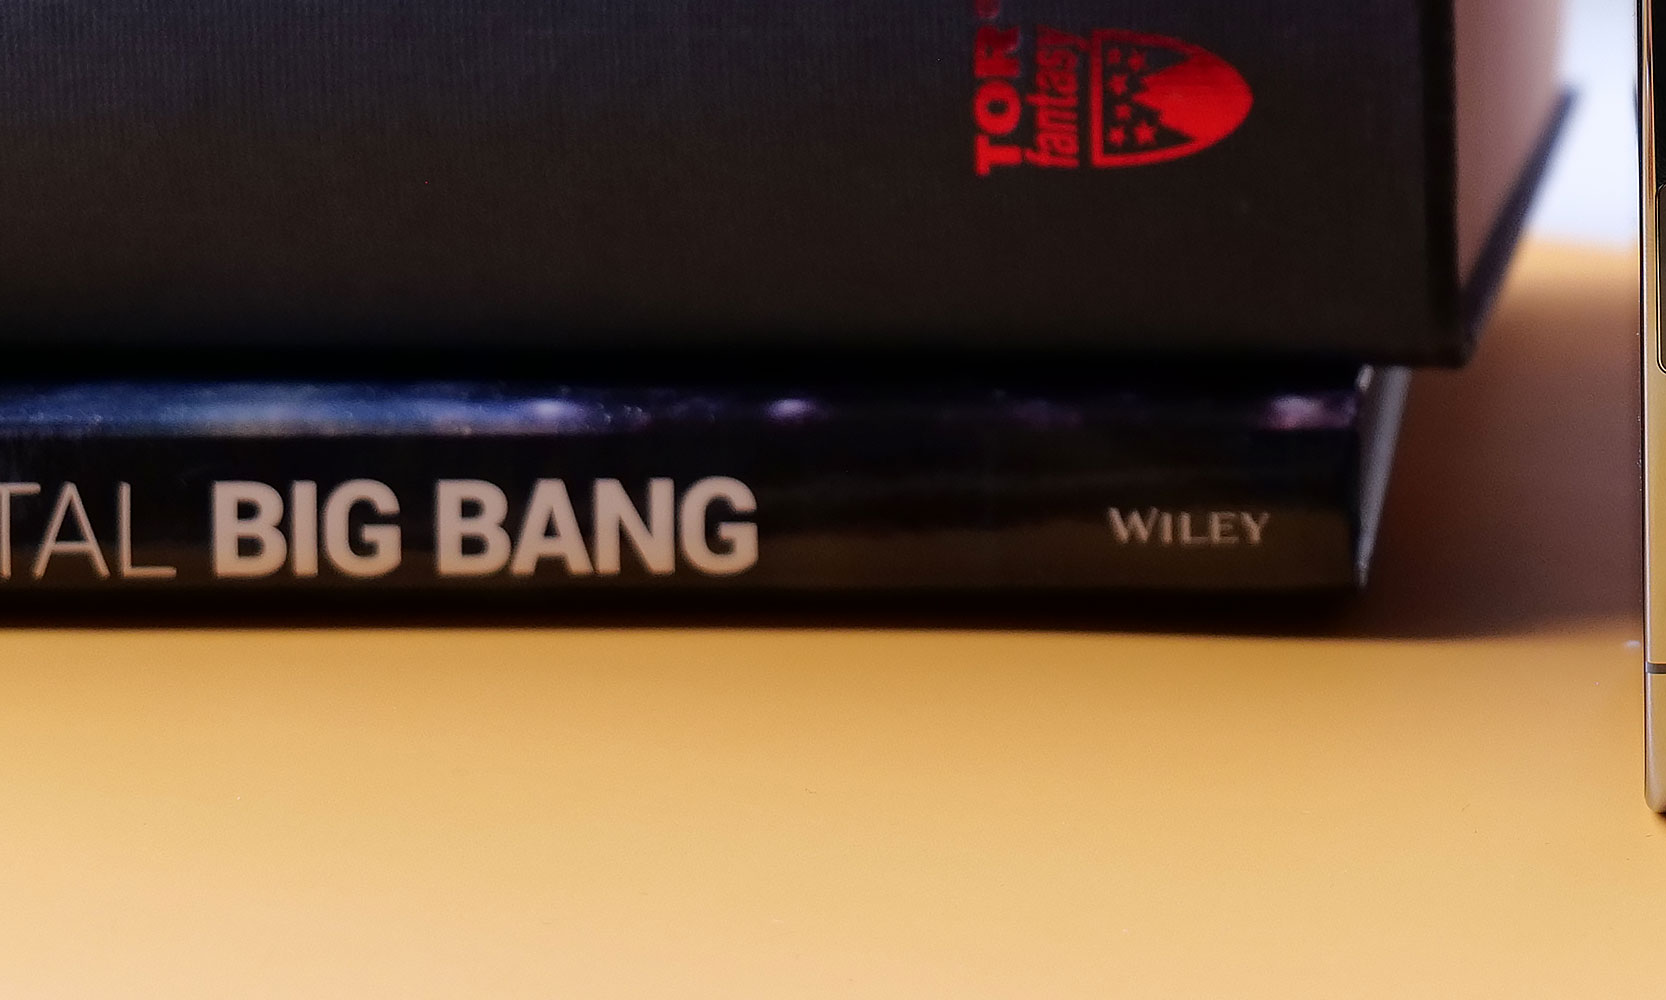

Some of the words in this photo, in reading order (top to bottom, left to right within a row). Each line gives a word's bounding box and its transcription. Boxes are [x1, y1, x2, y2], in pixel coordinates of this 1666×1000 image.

[1024, 23, 1090, 169] fantasy
[209, 478, 401, 580] BIG
[435, 474, 760, 579] BANG
[1107, 506, 1270, 545] WILEY
